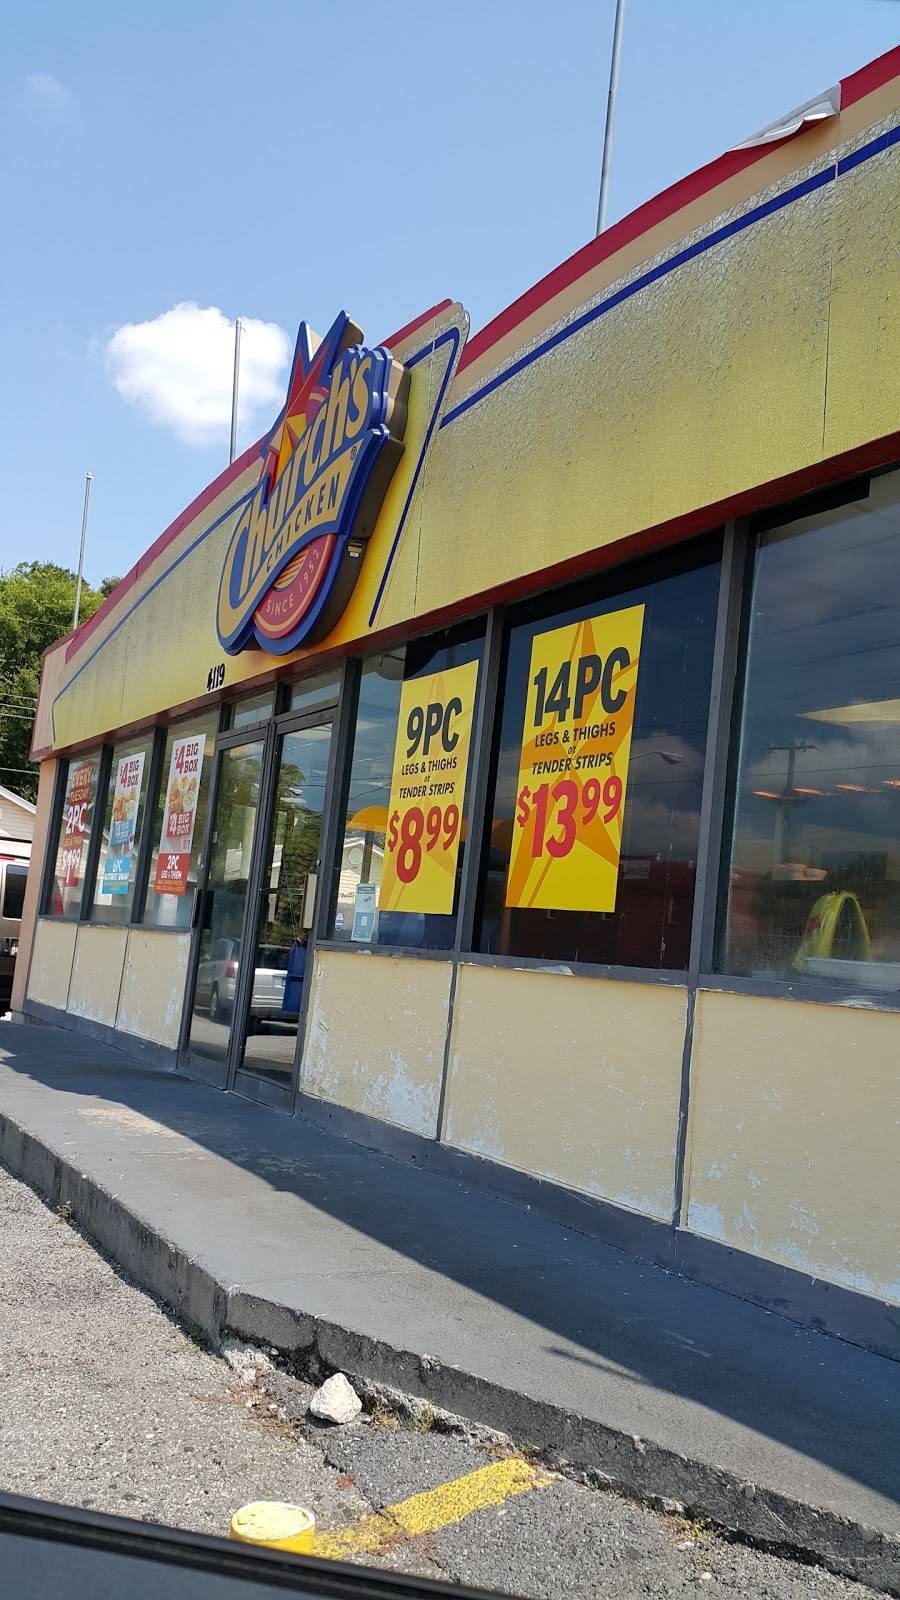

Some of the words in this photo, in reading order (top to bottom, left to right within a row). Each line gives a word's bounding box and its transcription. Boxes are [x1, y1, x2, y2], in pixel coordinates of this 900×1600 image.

[219, 357, 372, 638] Church's
[266, 471, 341, 573] CHICKEN
[265, 593, 294, 616] SINCE
[300, 549, 320, 593] 1952
[533, 647, 630, 727] 14PC
[406, 697, 462, 758] 9PC
[534, 731, 559, 748] LEGS
[562, 729, 570, 743] &
[573, 721, 616, 742] THIGHS
[186, 742, 199, 757] BIG
[128, 759, 140, 773] BIG
[184, 759, 199, 774] BOX
[401, 763, 419, 776] LEGS
[420, 762, 426, 773] &
[428, 757, 457, 772] THIGHS
[532, 758, 572, 775] TENDER
[574, 752, 613, 770] STRIPS
[127, 774, 140, 788] BOX
[400, 786, 427, 799] TENDER
[429, 782, 455, 796] STRIPS
[65, 802, 88, 834] 2PC
[178, 812, 190, 824] BIG
[176, 824, 190, 835] BOX
[166, 855, 179, 870] 2PC
